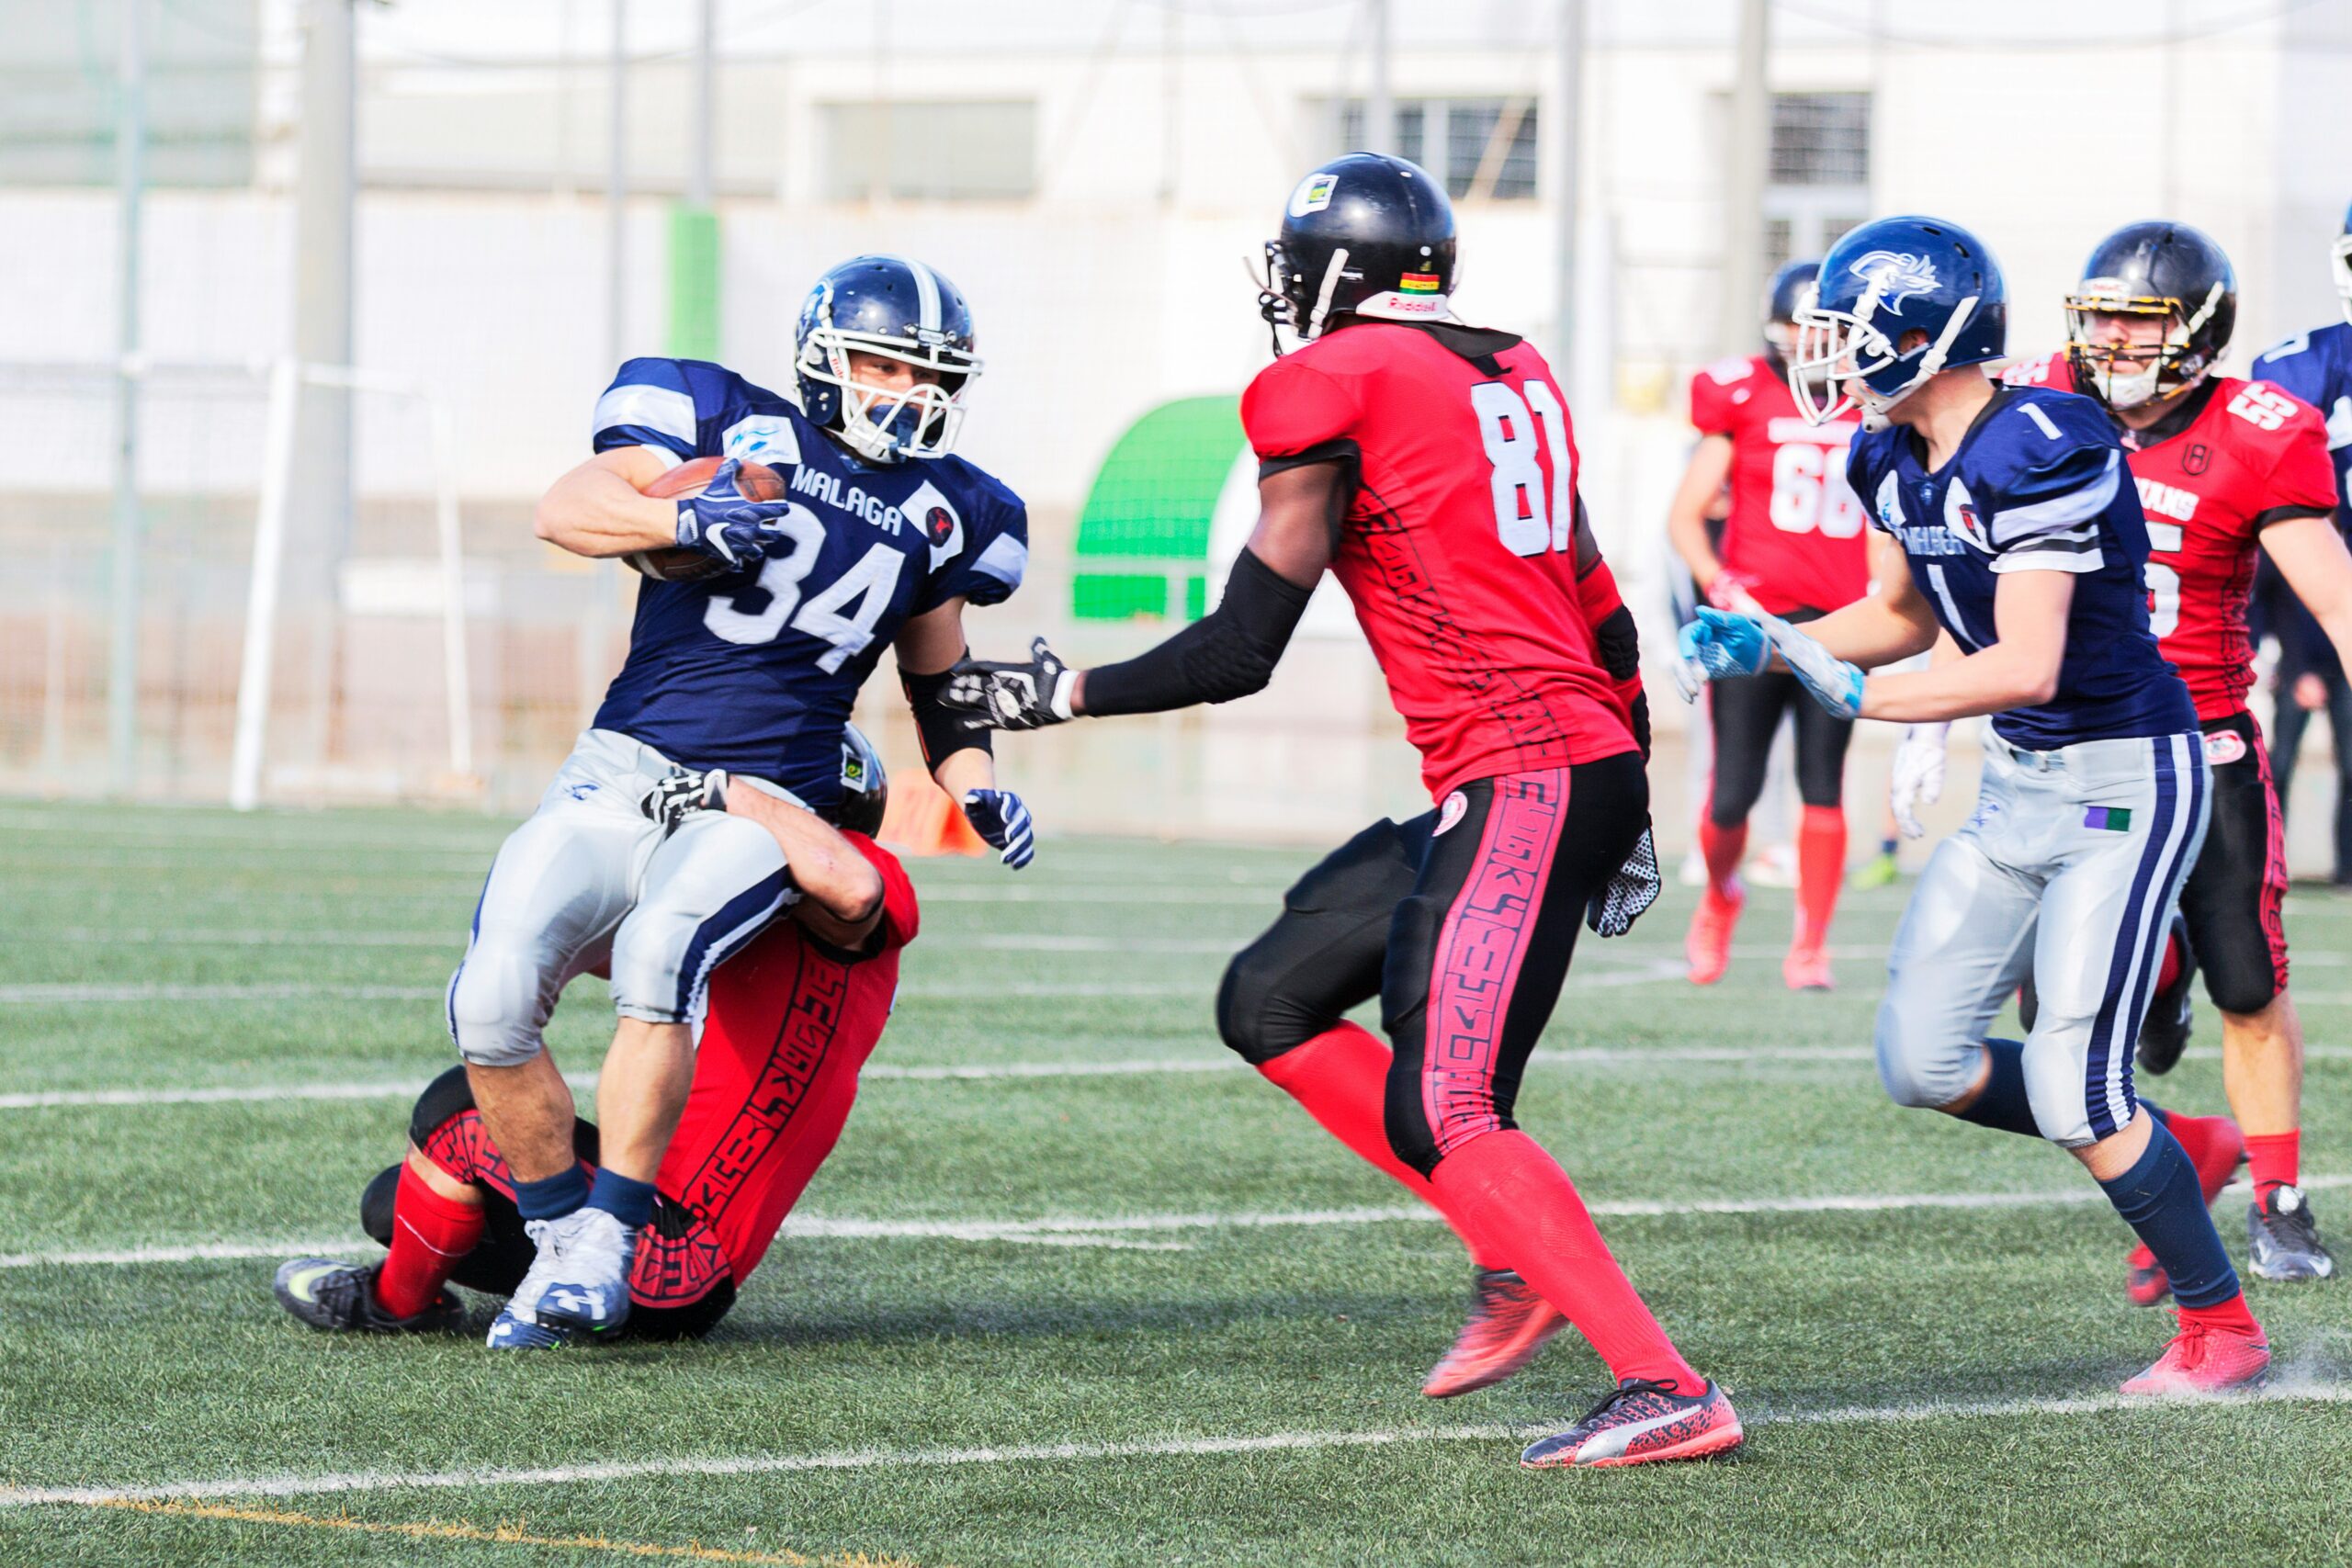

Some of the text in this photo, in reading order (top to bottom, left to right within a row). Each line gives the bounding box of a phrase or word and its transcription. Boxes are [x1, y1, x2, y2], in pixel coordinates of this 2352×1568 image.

[2017, 402, 2064, 440] 1
[2226, 382, 2299, 431] 55
[789, 463, 903, 536] MALAGA
[1470, 378, 1572, 558] 81
[703, 502, 906, 675] 34
